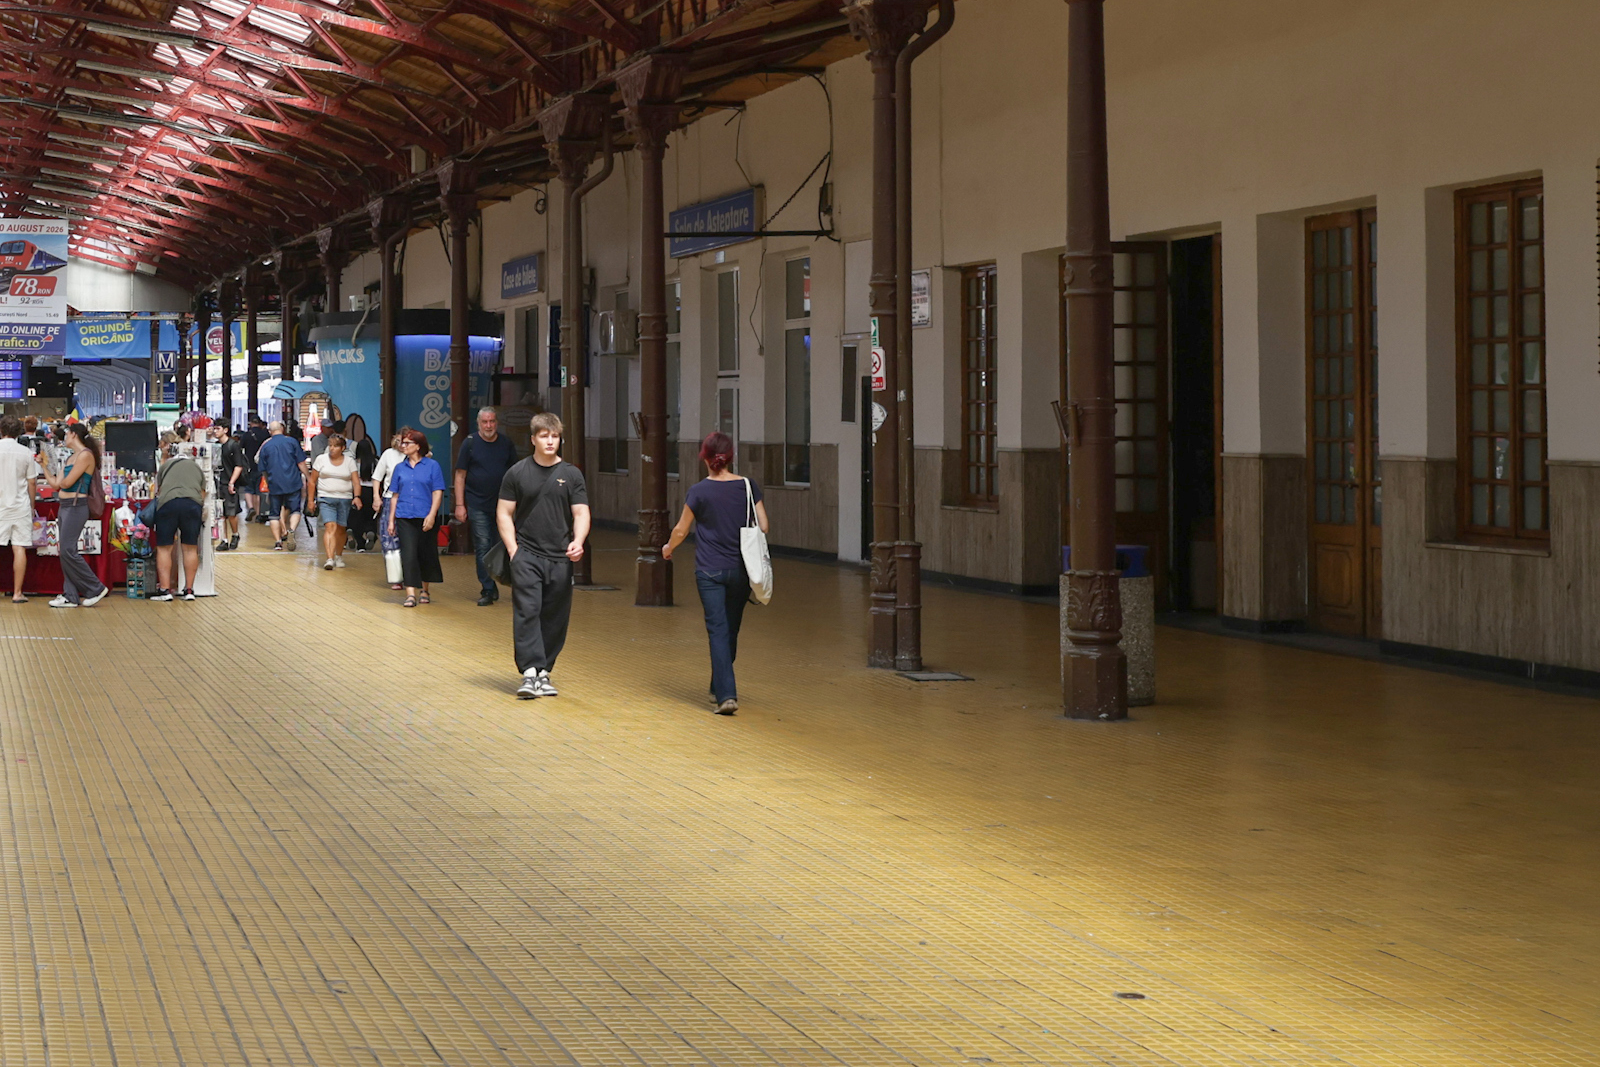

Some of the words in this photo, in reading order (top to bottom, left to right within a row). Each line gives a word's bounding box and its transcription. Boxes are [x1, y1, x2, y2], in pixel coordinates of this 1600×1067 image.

[6, 224, 45, 233] AUGUST
[514, 270, 521, 287] de
[522, 264, 537, 286] bilete
[14, 278, 38, 295] 78
[12, 325, 47, 334] ONLINE
[47, 326, 60, 335] PE
[81, 332, 134, 346] ORICÂND
[158, 352, 174, 369] M
[321, 348, 366, 364] SNACKS
